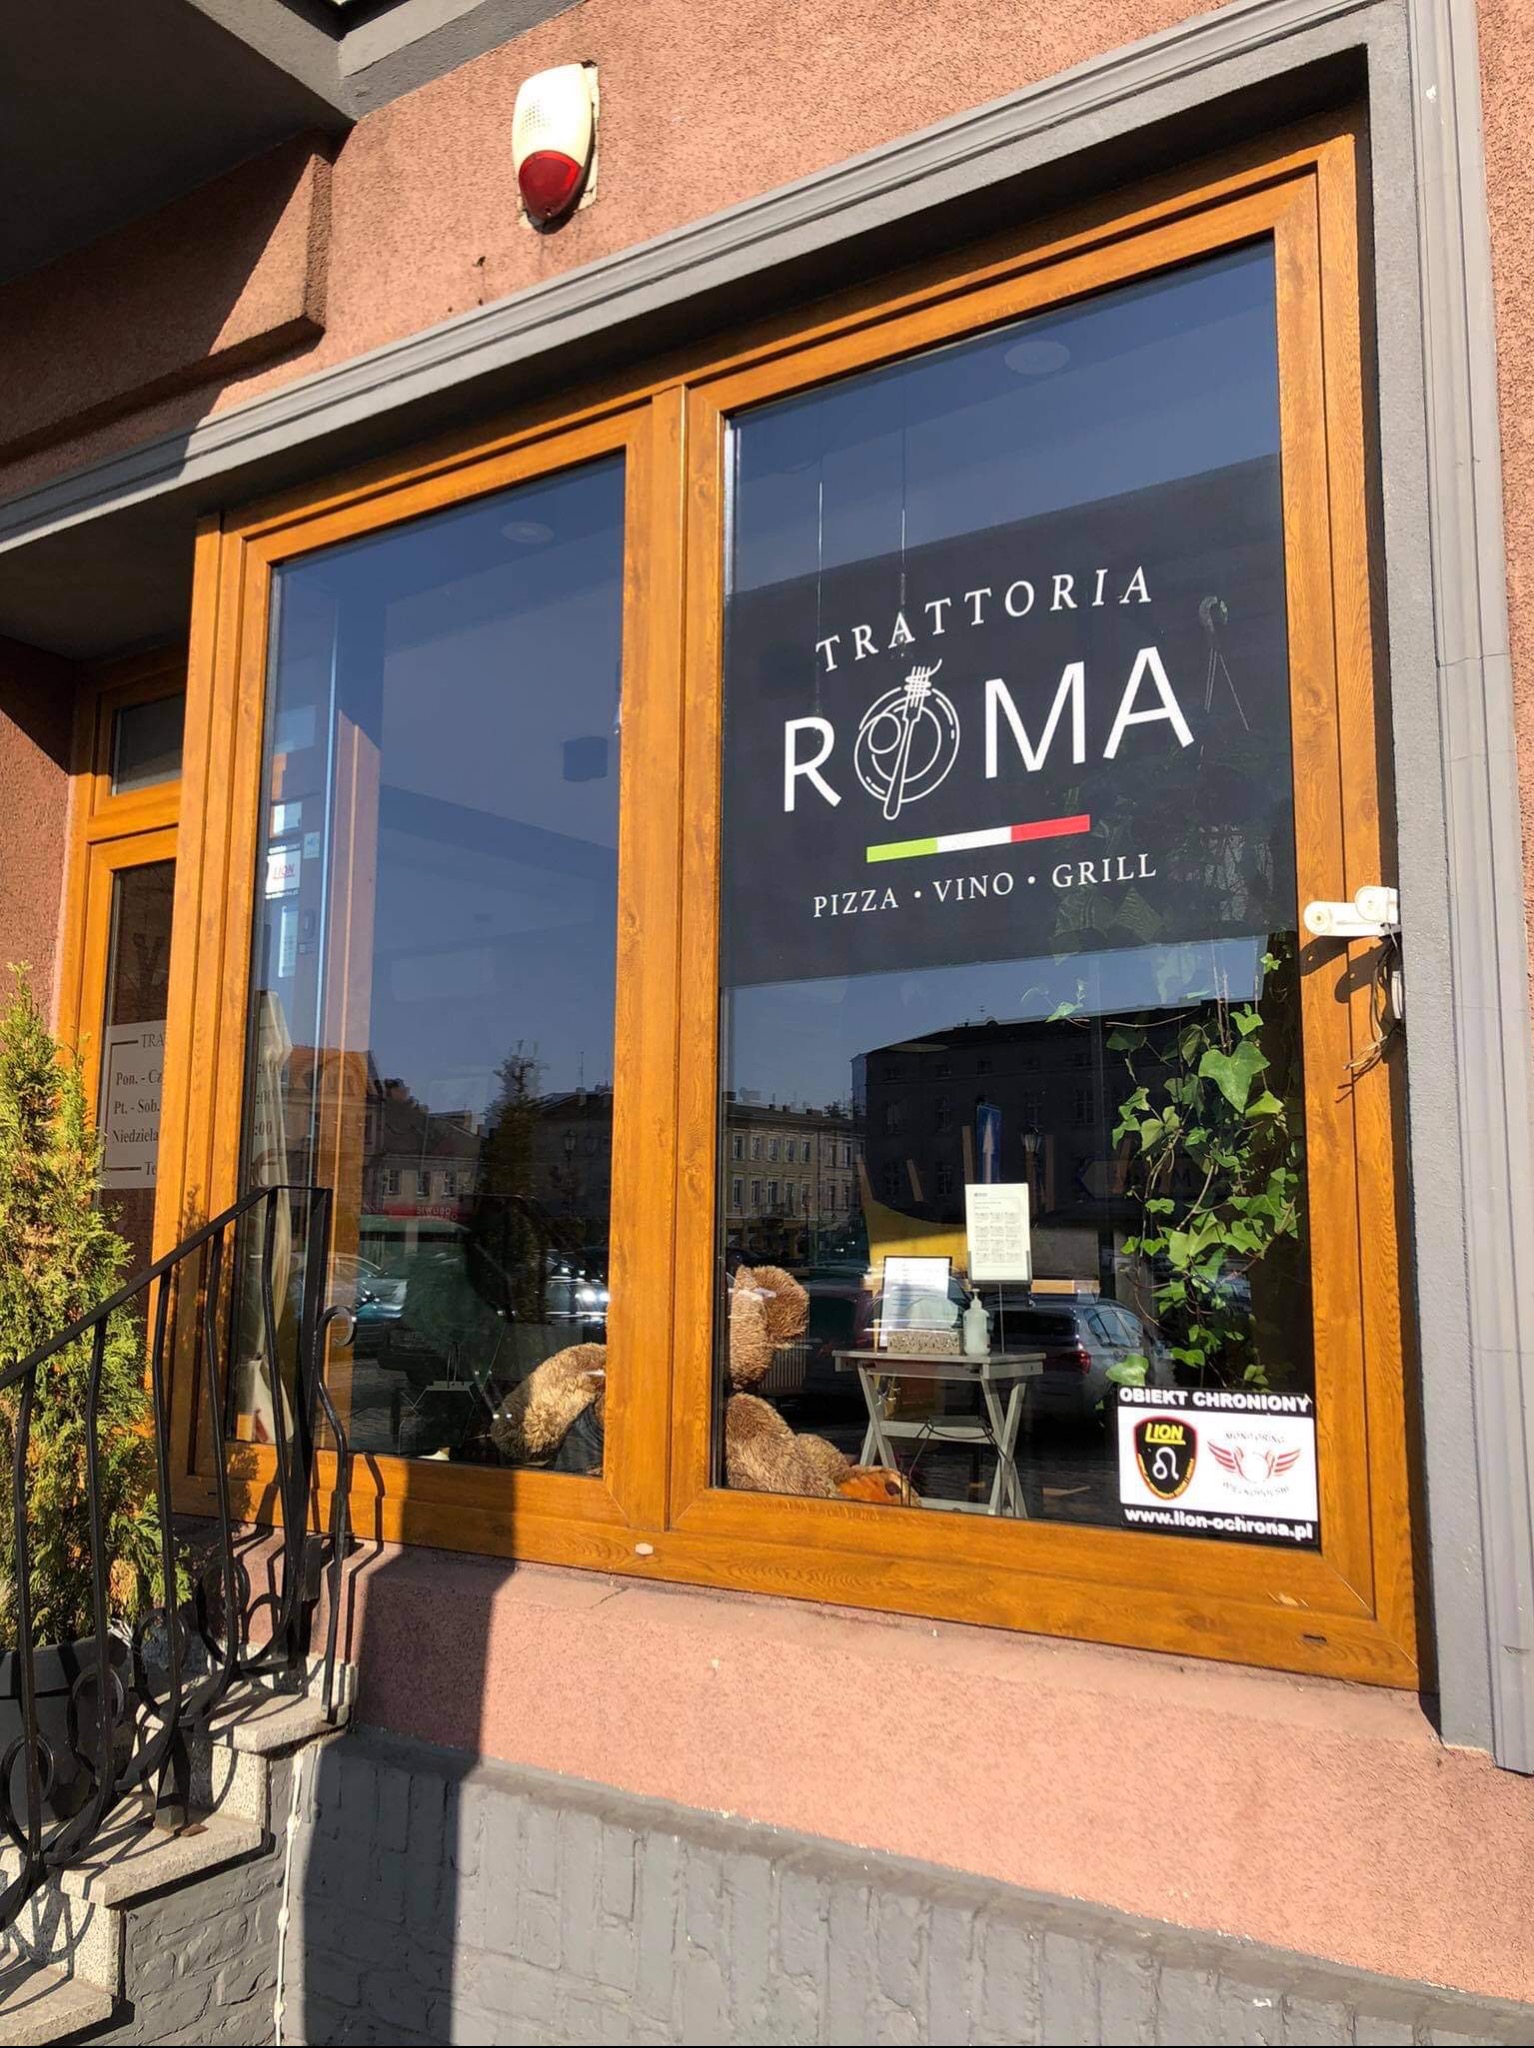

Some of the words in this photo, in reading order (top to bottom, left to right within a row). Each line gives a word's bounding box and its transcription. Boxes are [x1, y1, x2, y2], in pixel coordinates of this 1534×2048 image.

[814, 565, 1152, 672] TRATTORIA
[813, 887, 899, 918] PIZZA
[932, 872, 1014, 902] VINO
[1051, 853, 1157, 888] GRILL
[116, 1072, 138, 1086] Pon.
[114, 1101, 128, 1115] Pt.
[137, 1098, 160, 1113] Sob.
[1118, 1387, 1188, 1407] OBIEKT
[1192, 1391, 1310, 1413] CHRONIONY
[1145, 1422, 1187, 1446] LION
[1124, 1508, 1314, 1541] www.lion-ochrona.pl
